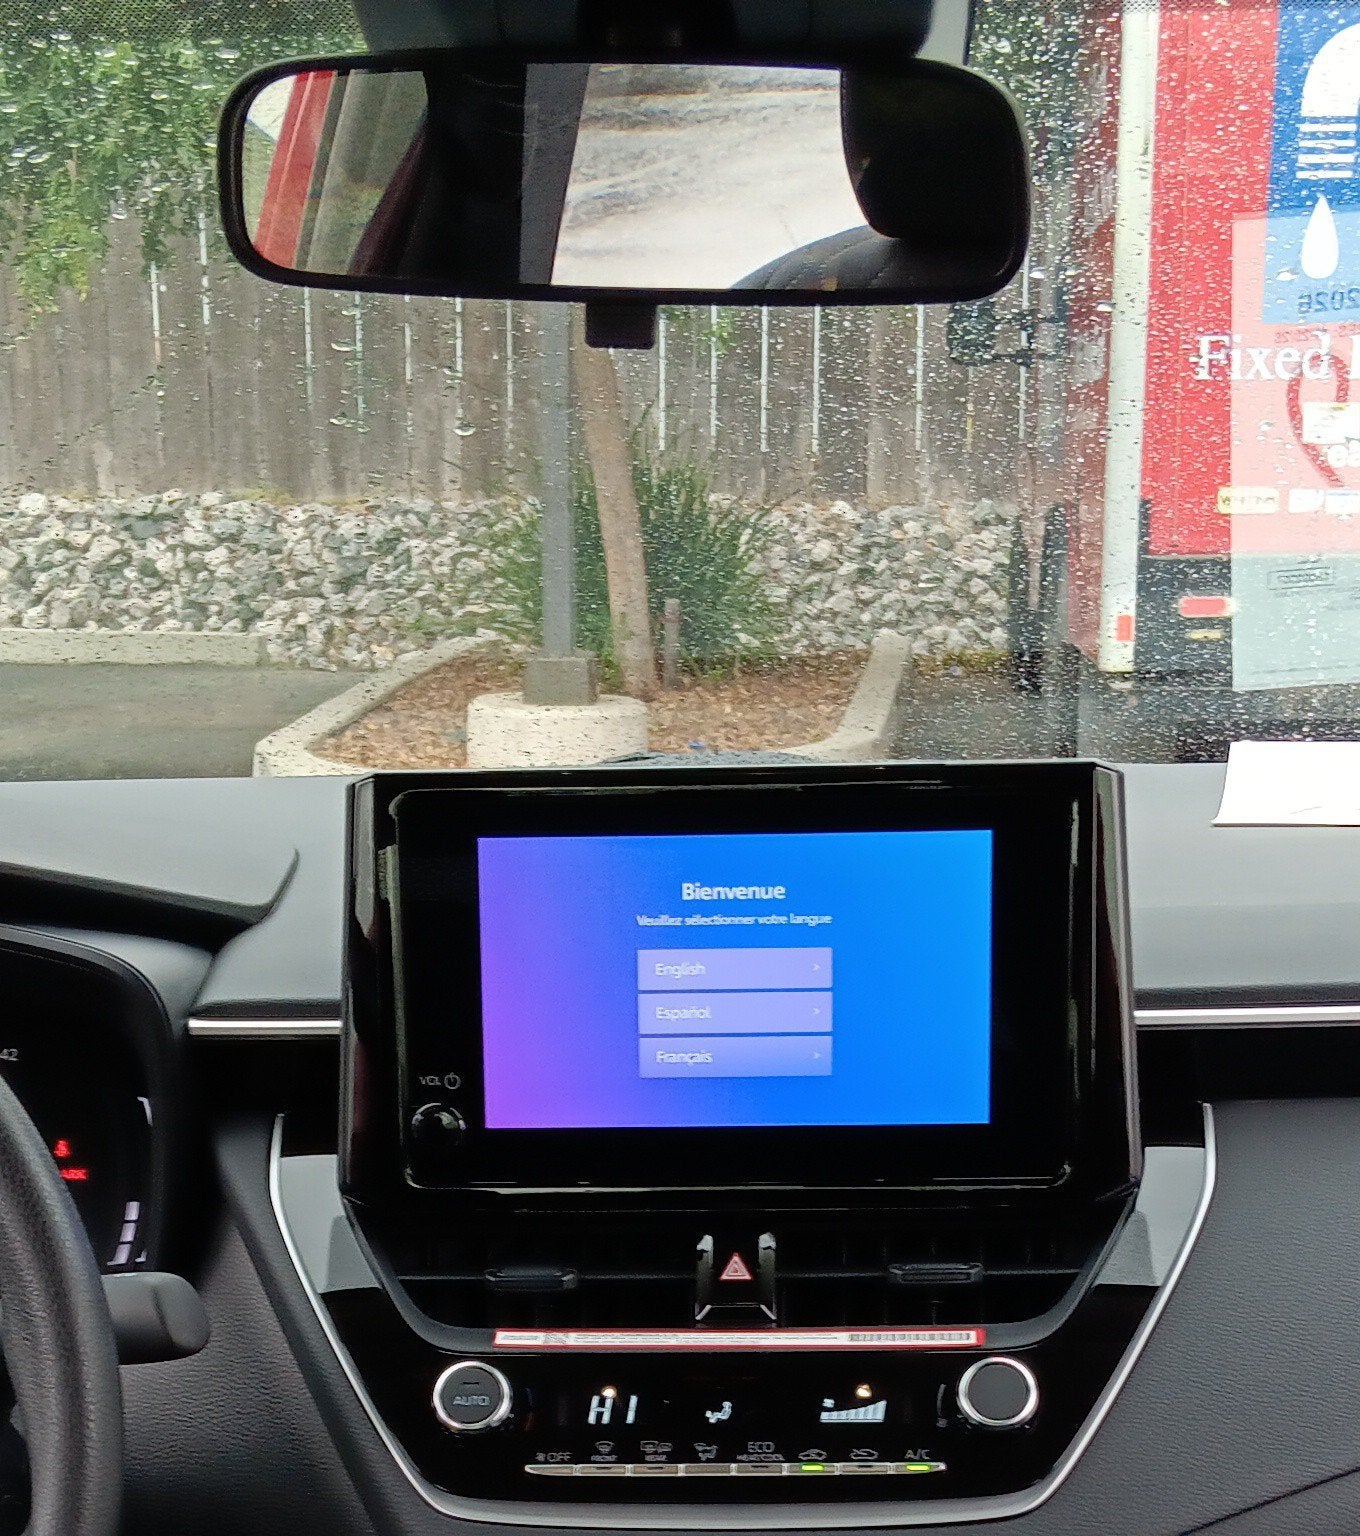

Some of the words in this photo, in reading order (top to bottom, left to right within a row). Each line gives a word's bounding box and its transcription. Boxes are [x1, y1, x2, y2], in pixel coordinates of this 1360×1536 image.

[1195, 332, 1331, 381] Fixed
[681, 882, 786, 901] Bienvenue
[790, 913, 833, 928] langue
[655, 960, 706, 979] English
[655, 1005, 712, 1022] Español
[655, 1049, 713, 1066] Français
[453, 1396, 491, 1406] AUTO
[747, 1441, 774, 1453] ECO
